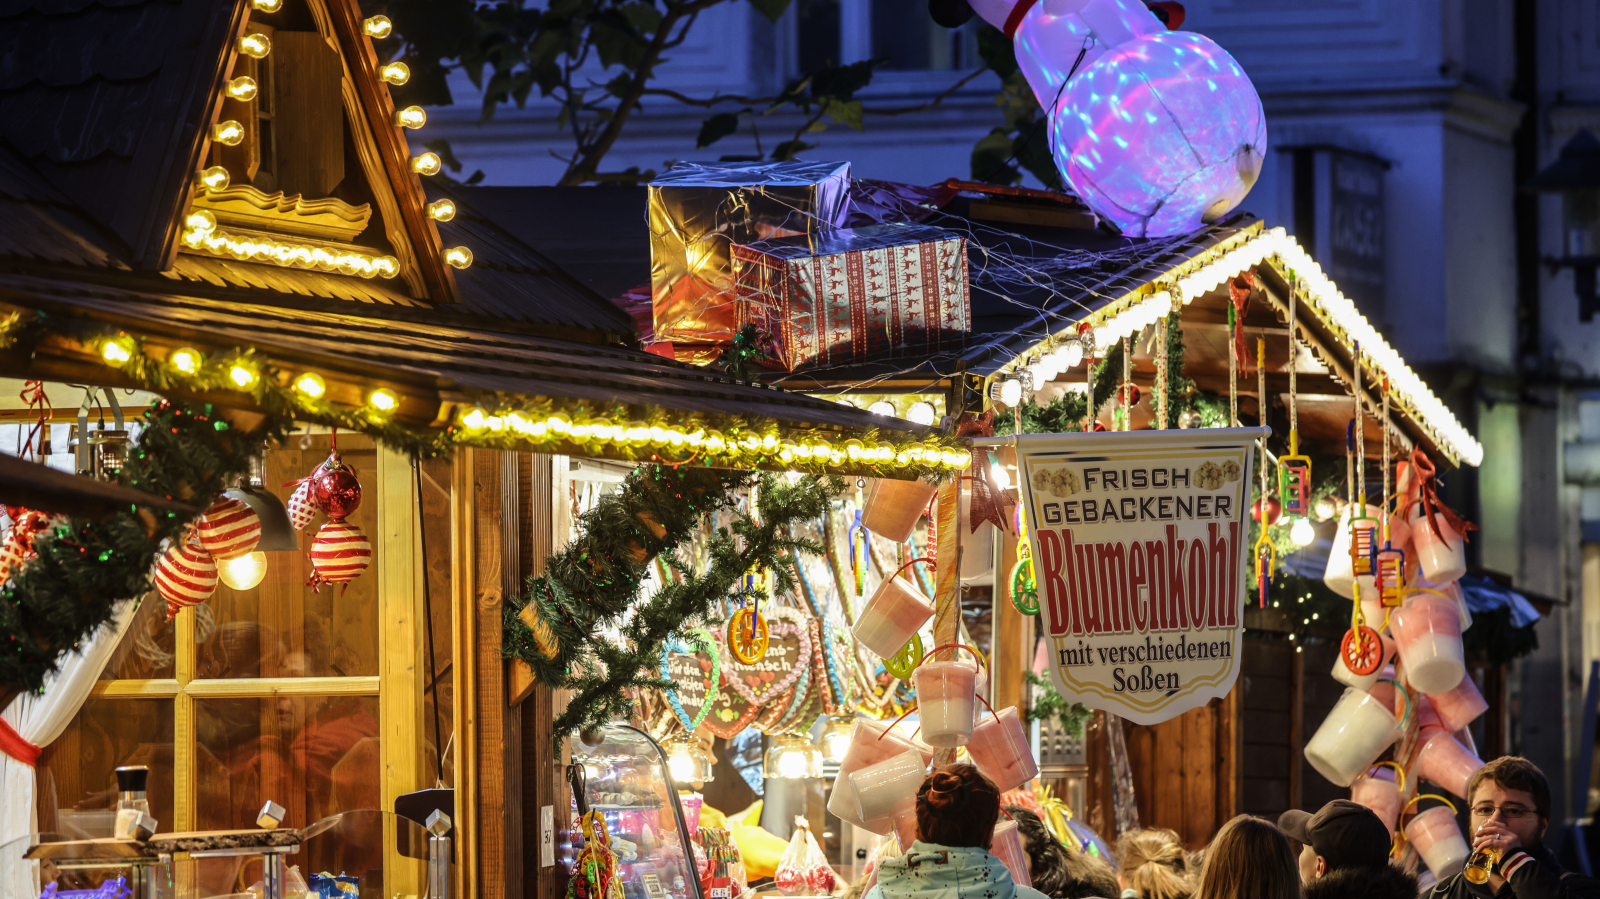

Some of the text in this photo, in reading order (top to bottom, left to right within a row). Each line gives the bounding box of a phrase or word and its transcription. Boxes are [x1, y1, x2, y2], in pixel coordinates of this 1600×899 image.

[1083, 467, 1189, 491] FRISCH
[1043, 495, 1232, 524] GEBACKENER
[1037, 521, 1239, 636] Blumenkohl
[1059, 634, 1232, 666] mit verschiedenen
[1113, 665, 1180, 692] Soßen
